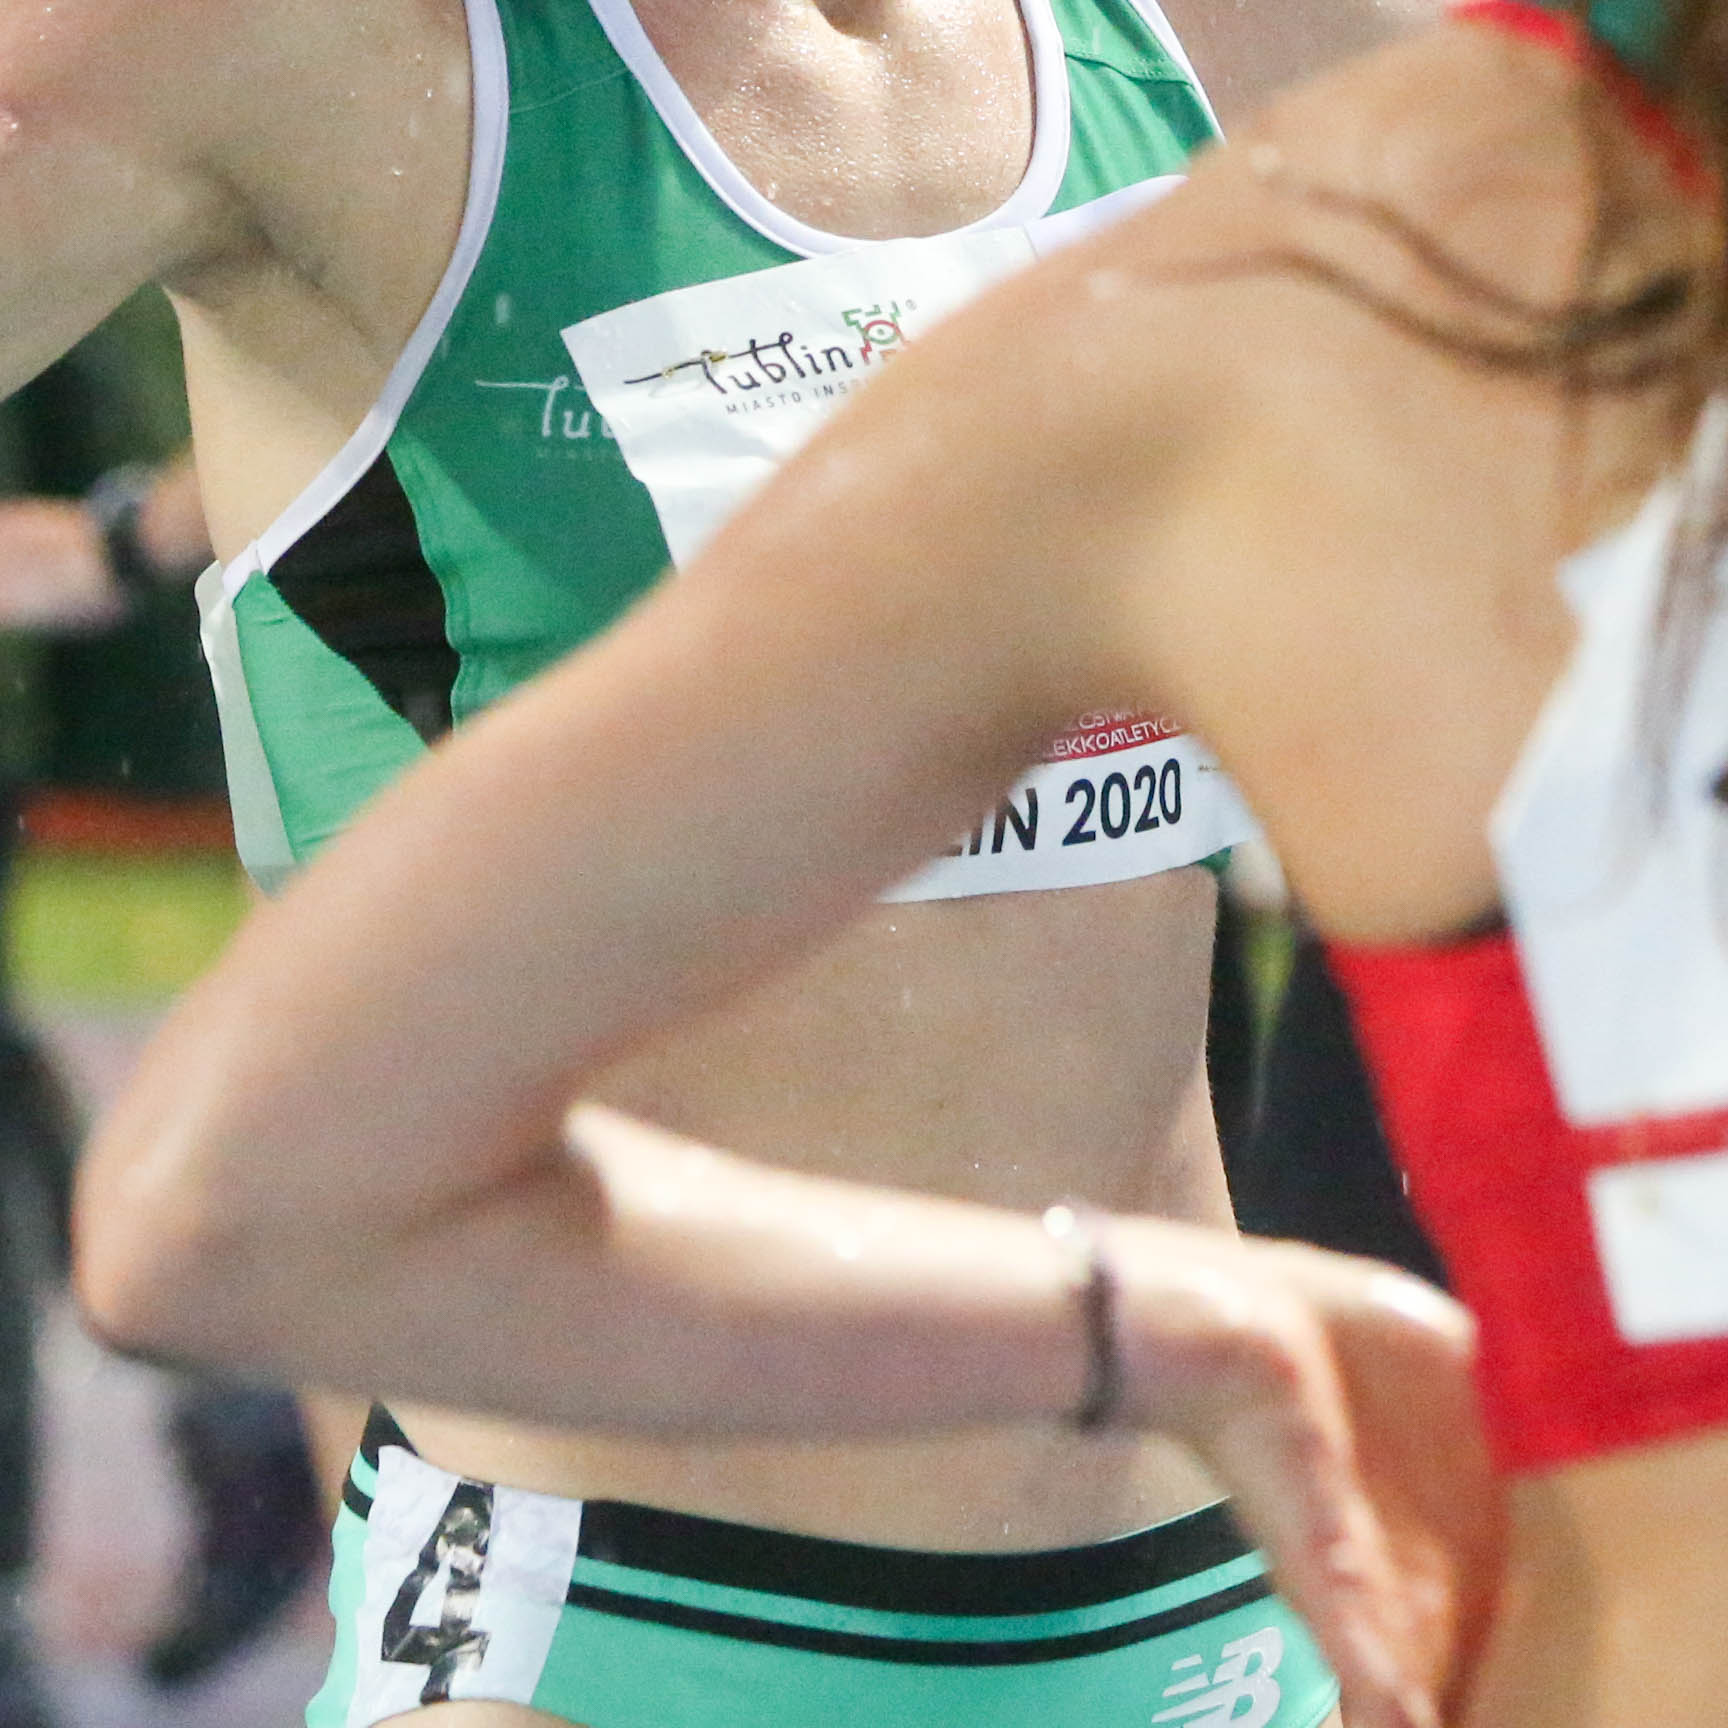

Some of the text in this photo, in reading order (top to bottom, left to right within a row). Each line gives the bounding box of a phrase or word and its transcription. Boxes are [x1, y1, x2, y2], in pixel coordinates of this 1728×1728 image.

[725, 390, 802, 415] MIASTO
[1061, 757, 1182, 847] 2020
[381, 1478, 495, 1706] 4
